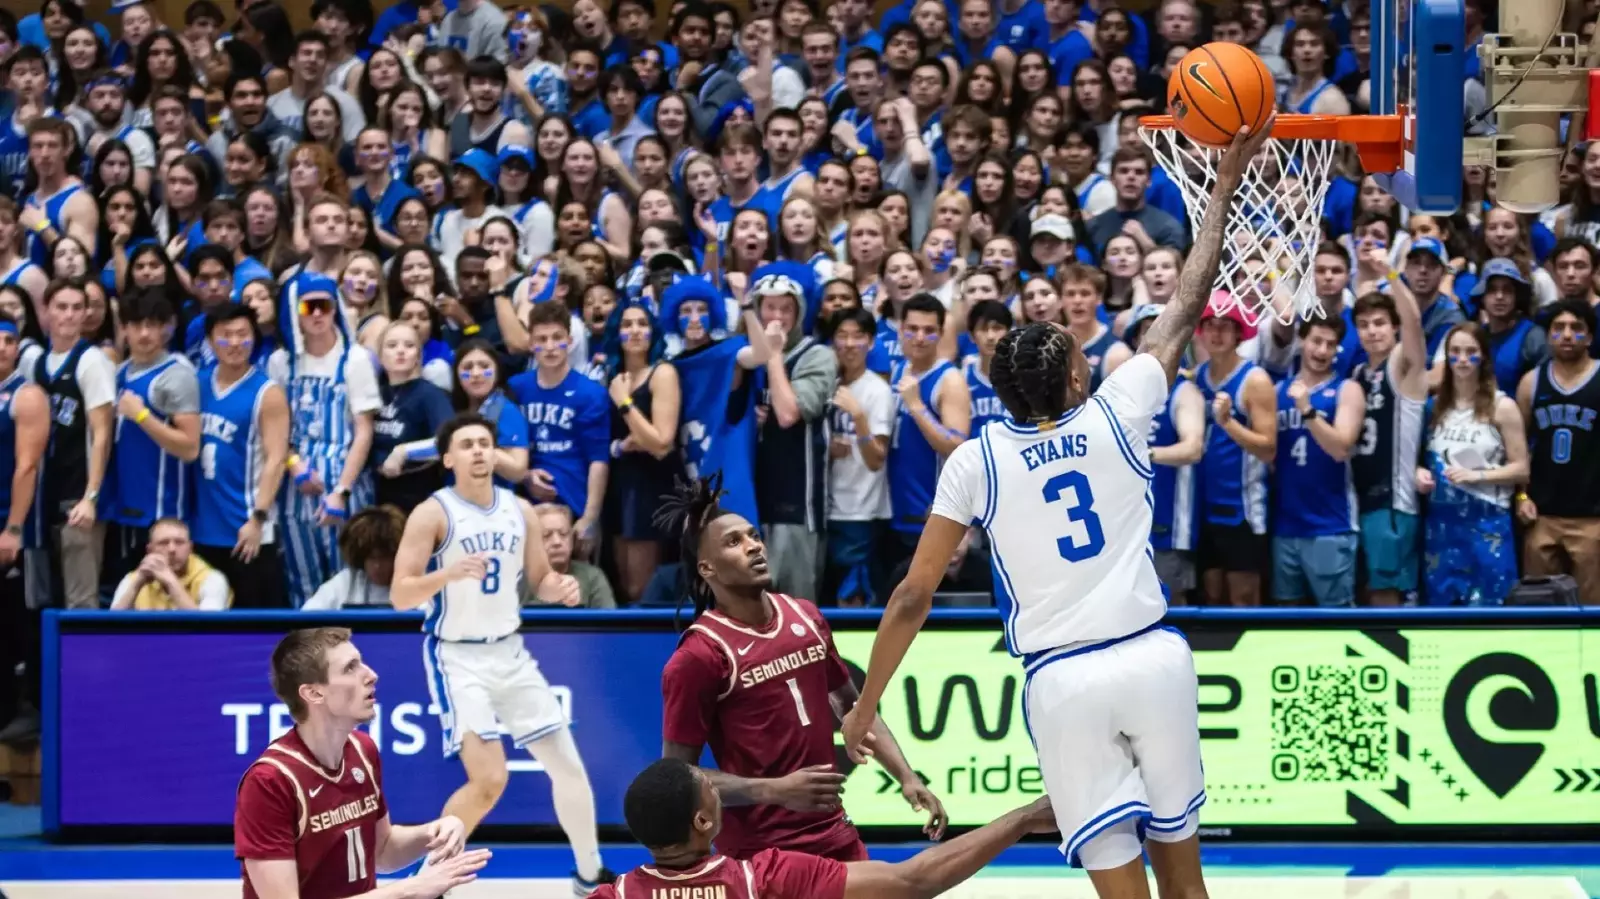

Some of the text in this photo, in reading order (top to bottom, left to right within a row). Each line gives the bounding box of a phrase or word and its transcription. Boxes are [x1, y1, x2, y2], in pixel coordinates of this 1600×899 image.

[1535, 404, 1597, 431] DUKE
[1020, 434, 1087, 471] EVANS
[1290, 435, 1307, 466] 4
[1552, 428, 1572, 464] 0
[1042, 469, 1106, 563] 3
[460, 532, 520, 554] DUKE
[479, 556, 500, 594] 8
[740, 645, 827, 689] SEMINOLES
[786, 679, 811, 726] 1
[309, 794, 378, 832] SEMINOLES
[344, 827, 367, 882] 11
